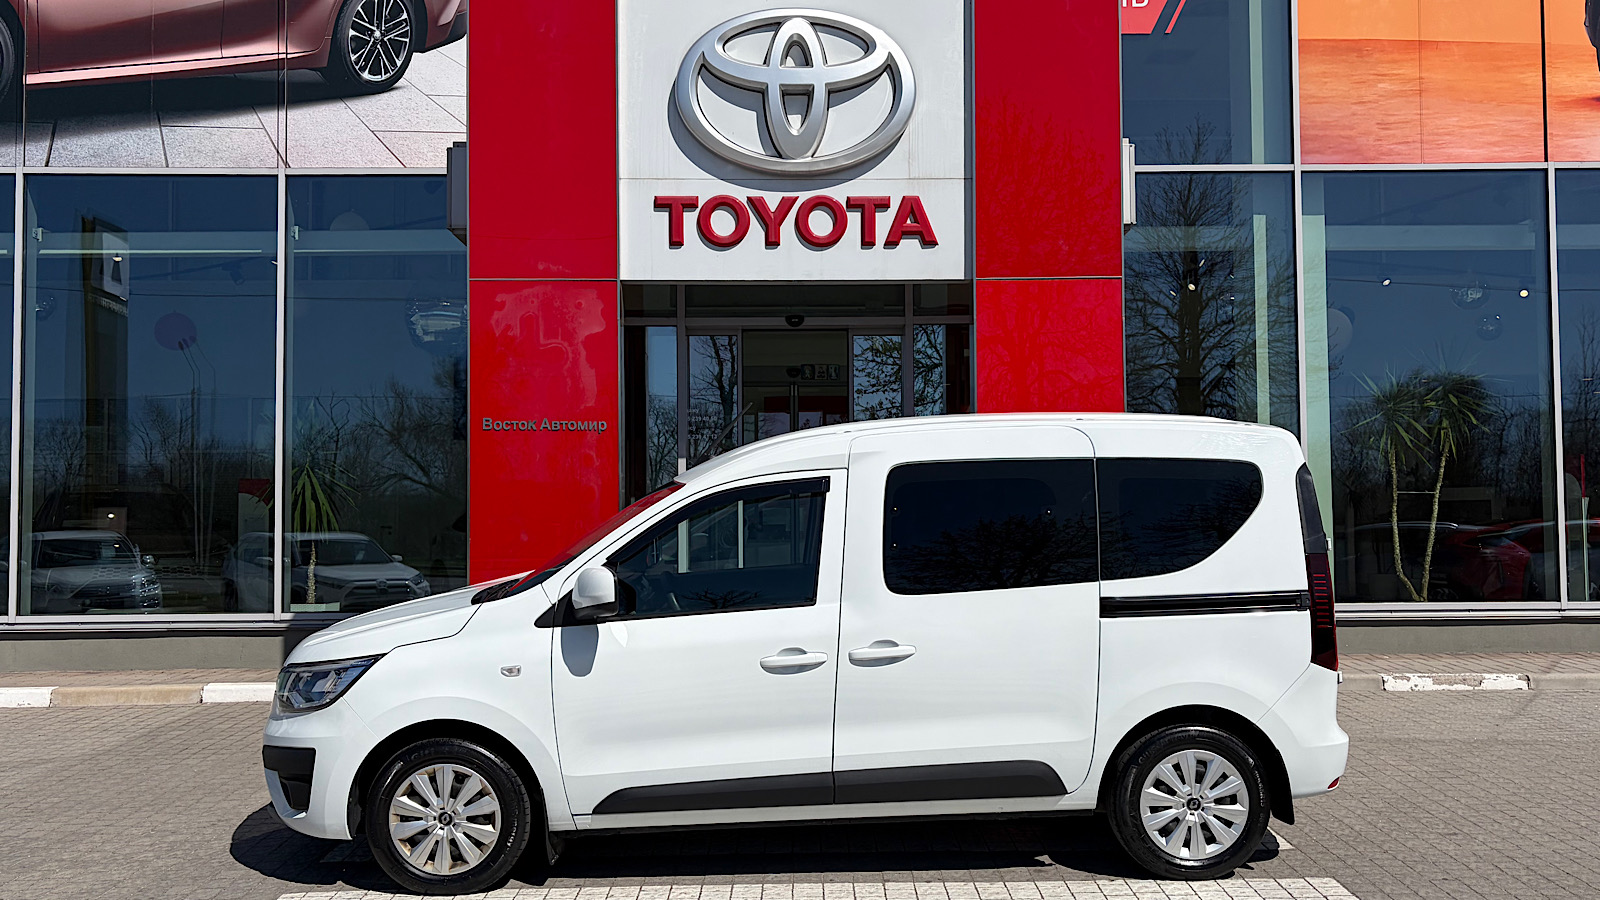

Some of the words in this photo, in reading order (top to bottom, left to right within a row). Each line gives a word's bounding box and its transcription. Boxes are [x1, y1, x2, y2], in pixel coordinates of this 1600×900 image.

[654, 194, 938, 247] TOYOTA
[482, 417, 538, 431] Восток
[540, 417, 608, 434] Автомир
